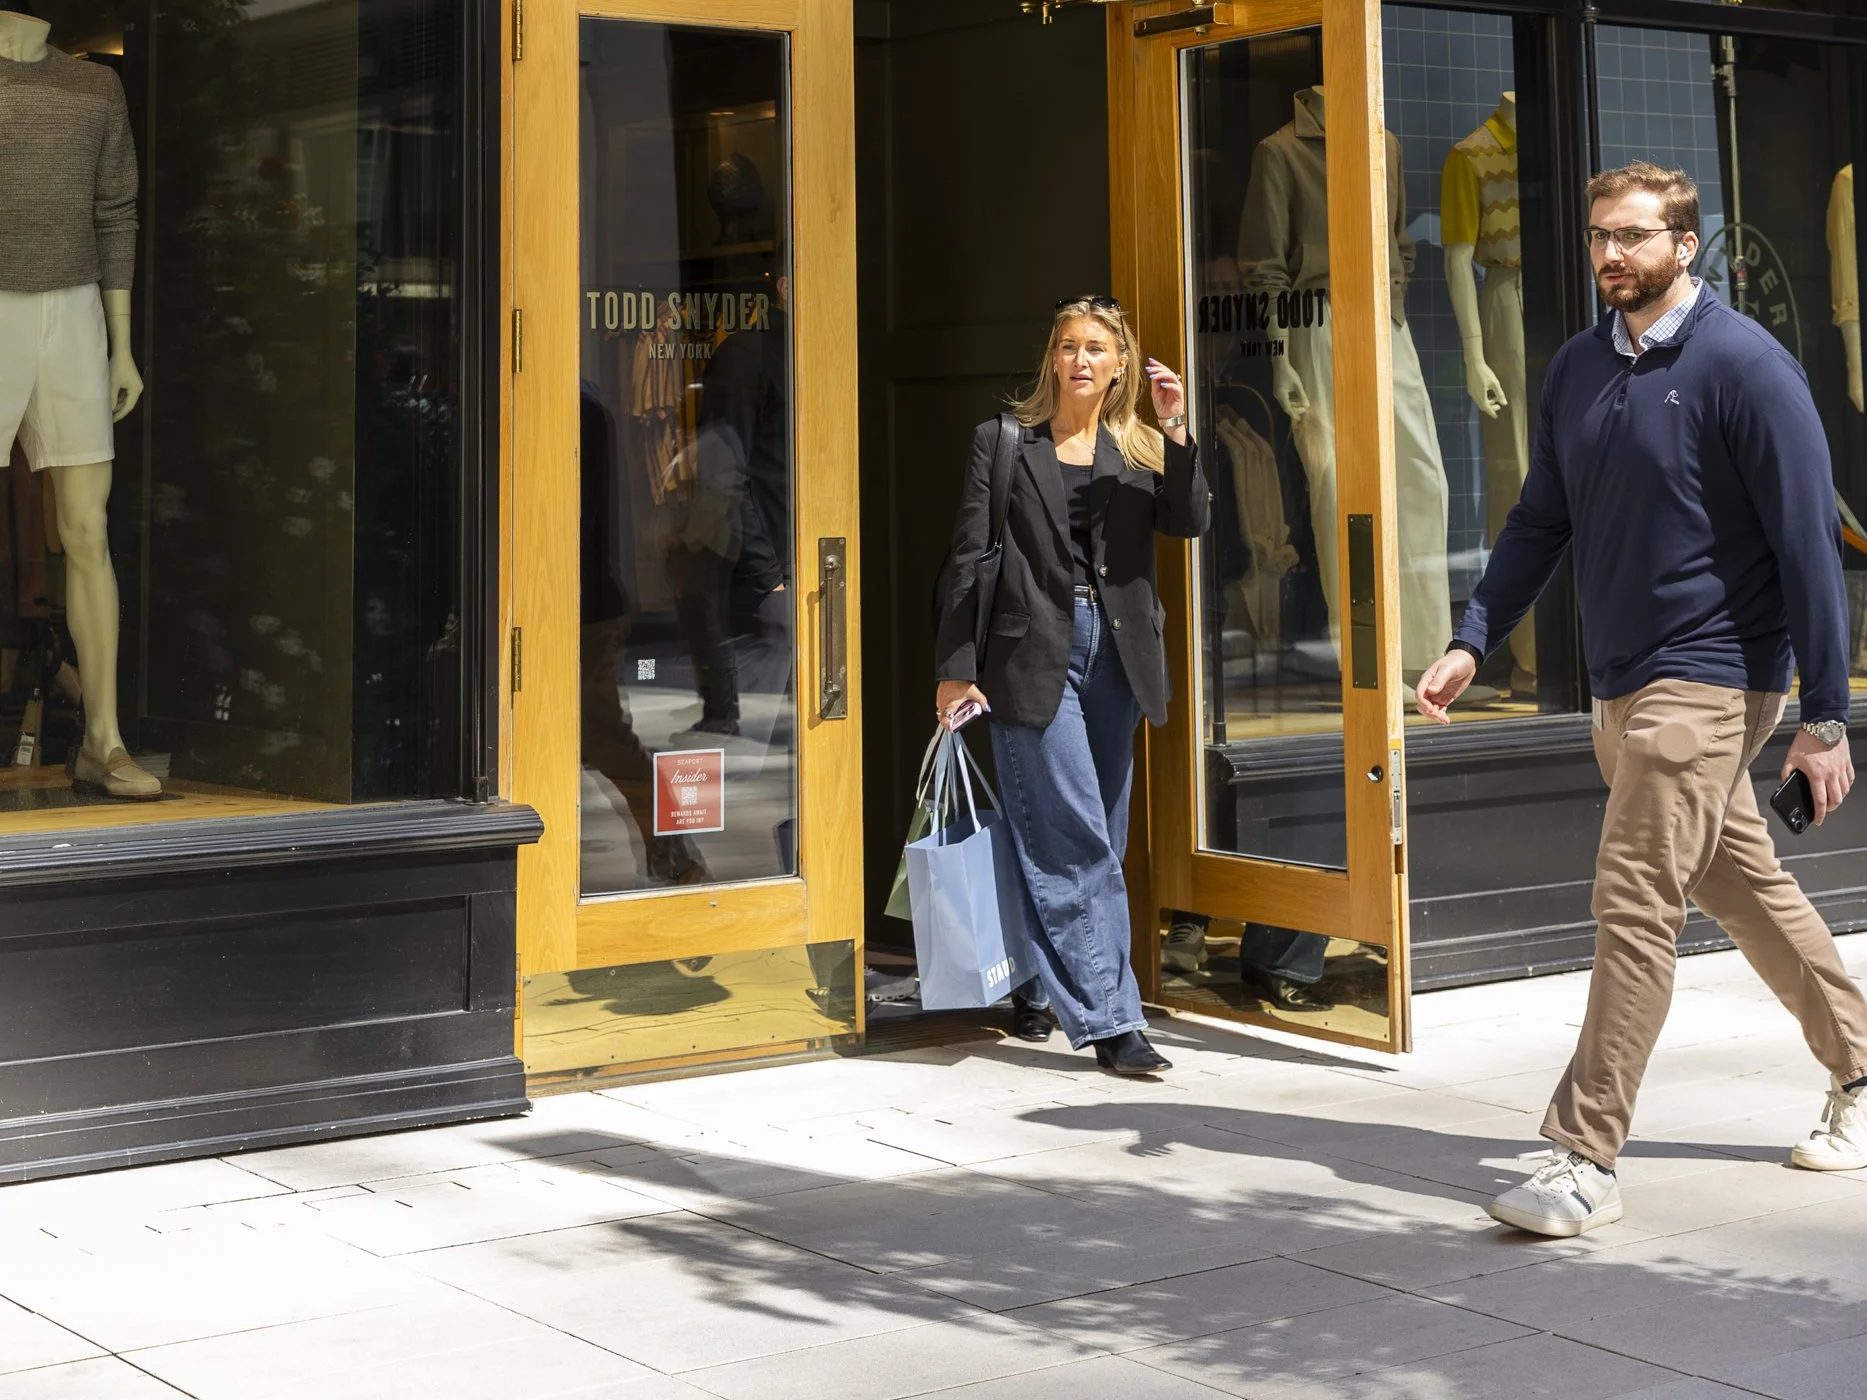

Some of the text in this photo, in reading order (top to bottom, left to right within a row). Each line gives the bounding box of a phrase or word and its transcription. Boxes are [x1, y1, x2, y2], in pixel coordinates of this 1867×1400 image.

[587, 291, 771, 331] TODD SNYDER
[648, 343, 712, 360] NEW YORK
[670, 767, 708, 784] Insider
[986, 956, 1016, 989] STAUD
